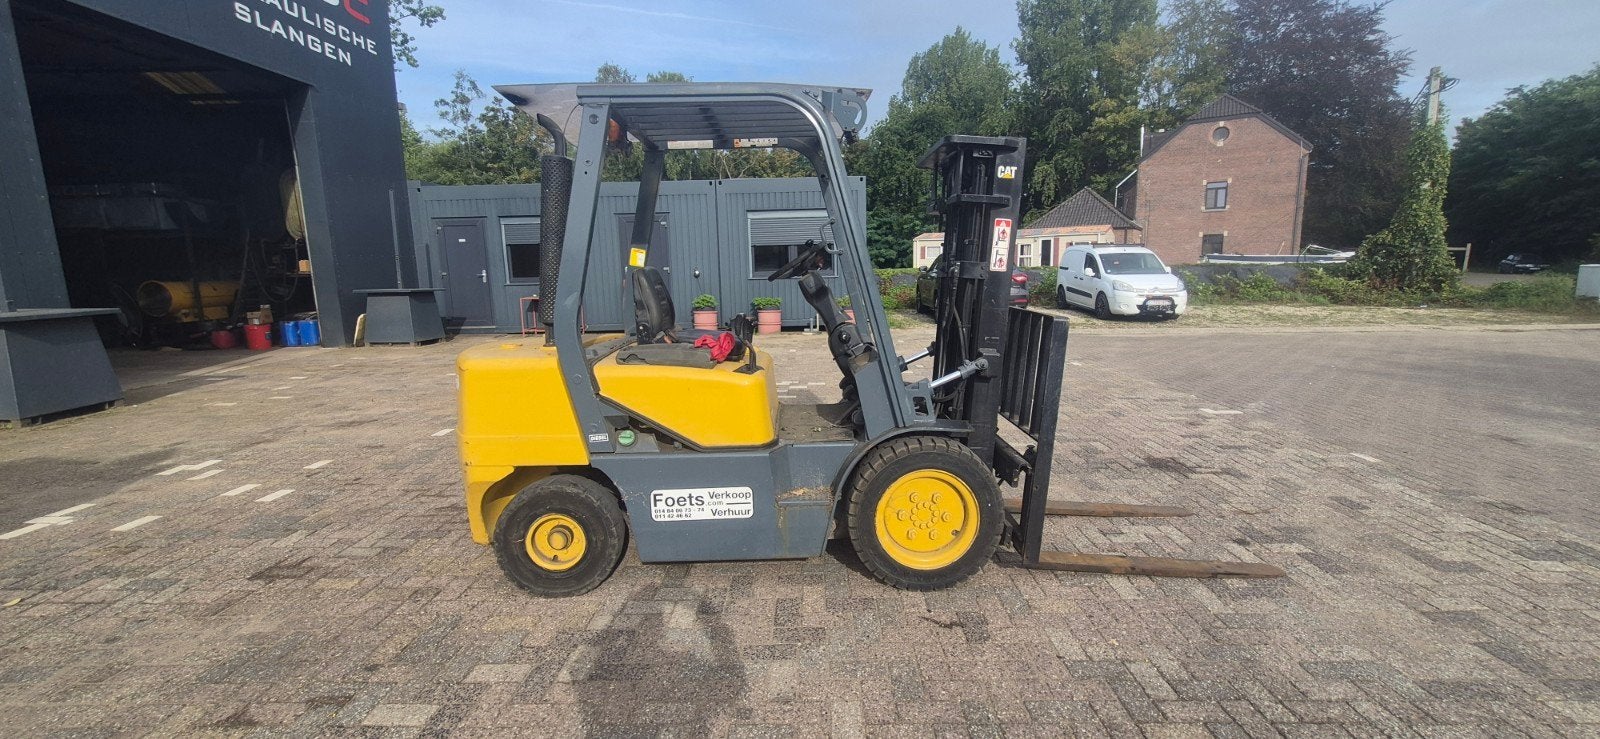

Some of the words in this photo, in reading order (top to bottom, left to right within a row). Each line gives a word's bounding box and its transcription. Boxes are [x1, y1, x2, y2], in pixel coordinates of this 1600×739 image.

[234, 2, 352, 66] SLANGEN
[260, 0, 378, 55] AULISCHE
[997, 166, 1018, 179] CAT
[653, 493, 705, 508] Foets
[708, 491, 752, 500] Verkoop
[710, 508, 752, 517] Verhuur
